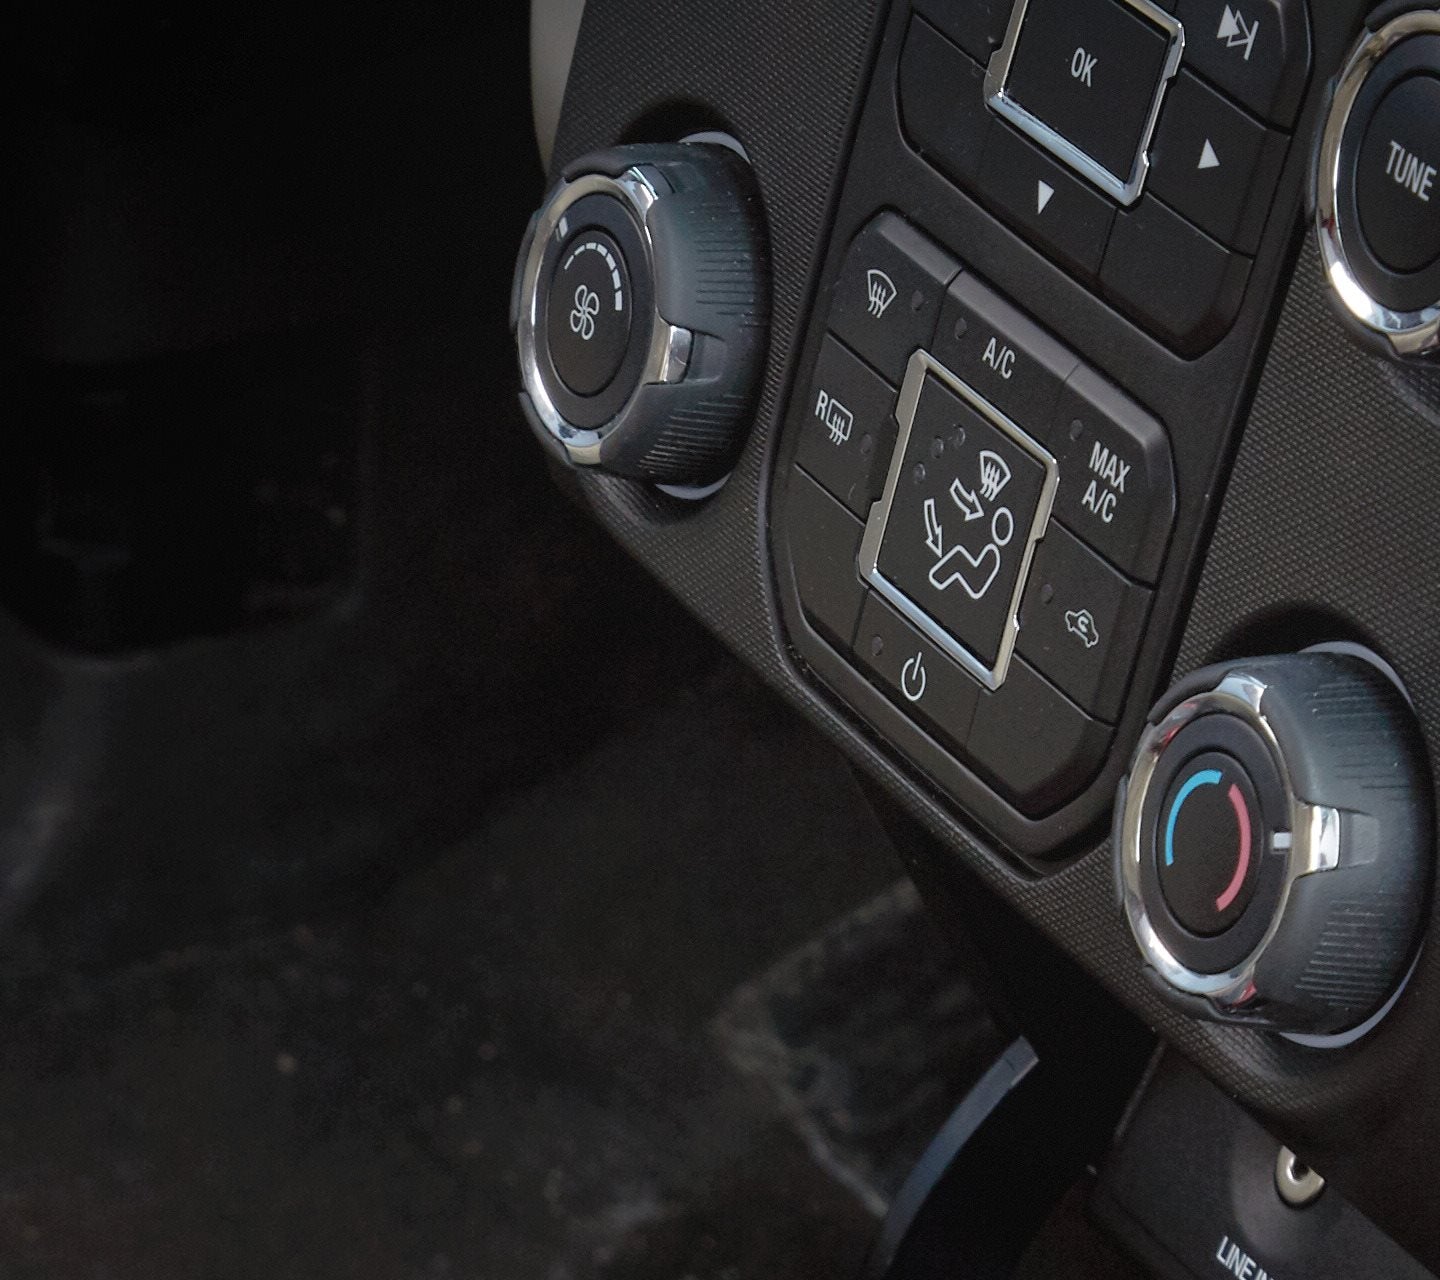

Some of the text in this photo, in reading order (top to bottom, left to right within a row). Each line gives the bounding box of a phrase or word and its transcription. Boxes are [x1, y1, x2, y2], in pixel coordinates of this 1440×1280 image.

[1071, 47, 1098, 88] OK
[1385, 140, 1437, 201] TUNE
[982, 337, 1017, 379] A/C
[1089, 440, 1131, 494] MAX
[1082, 479, 1118, 523] A/C
